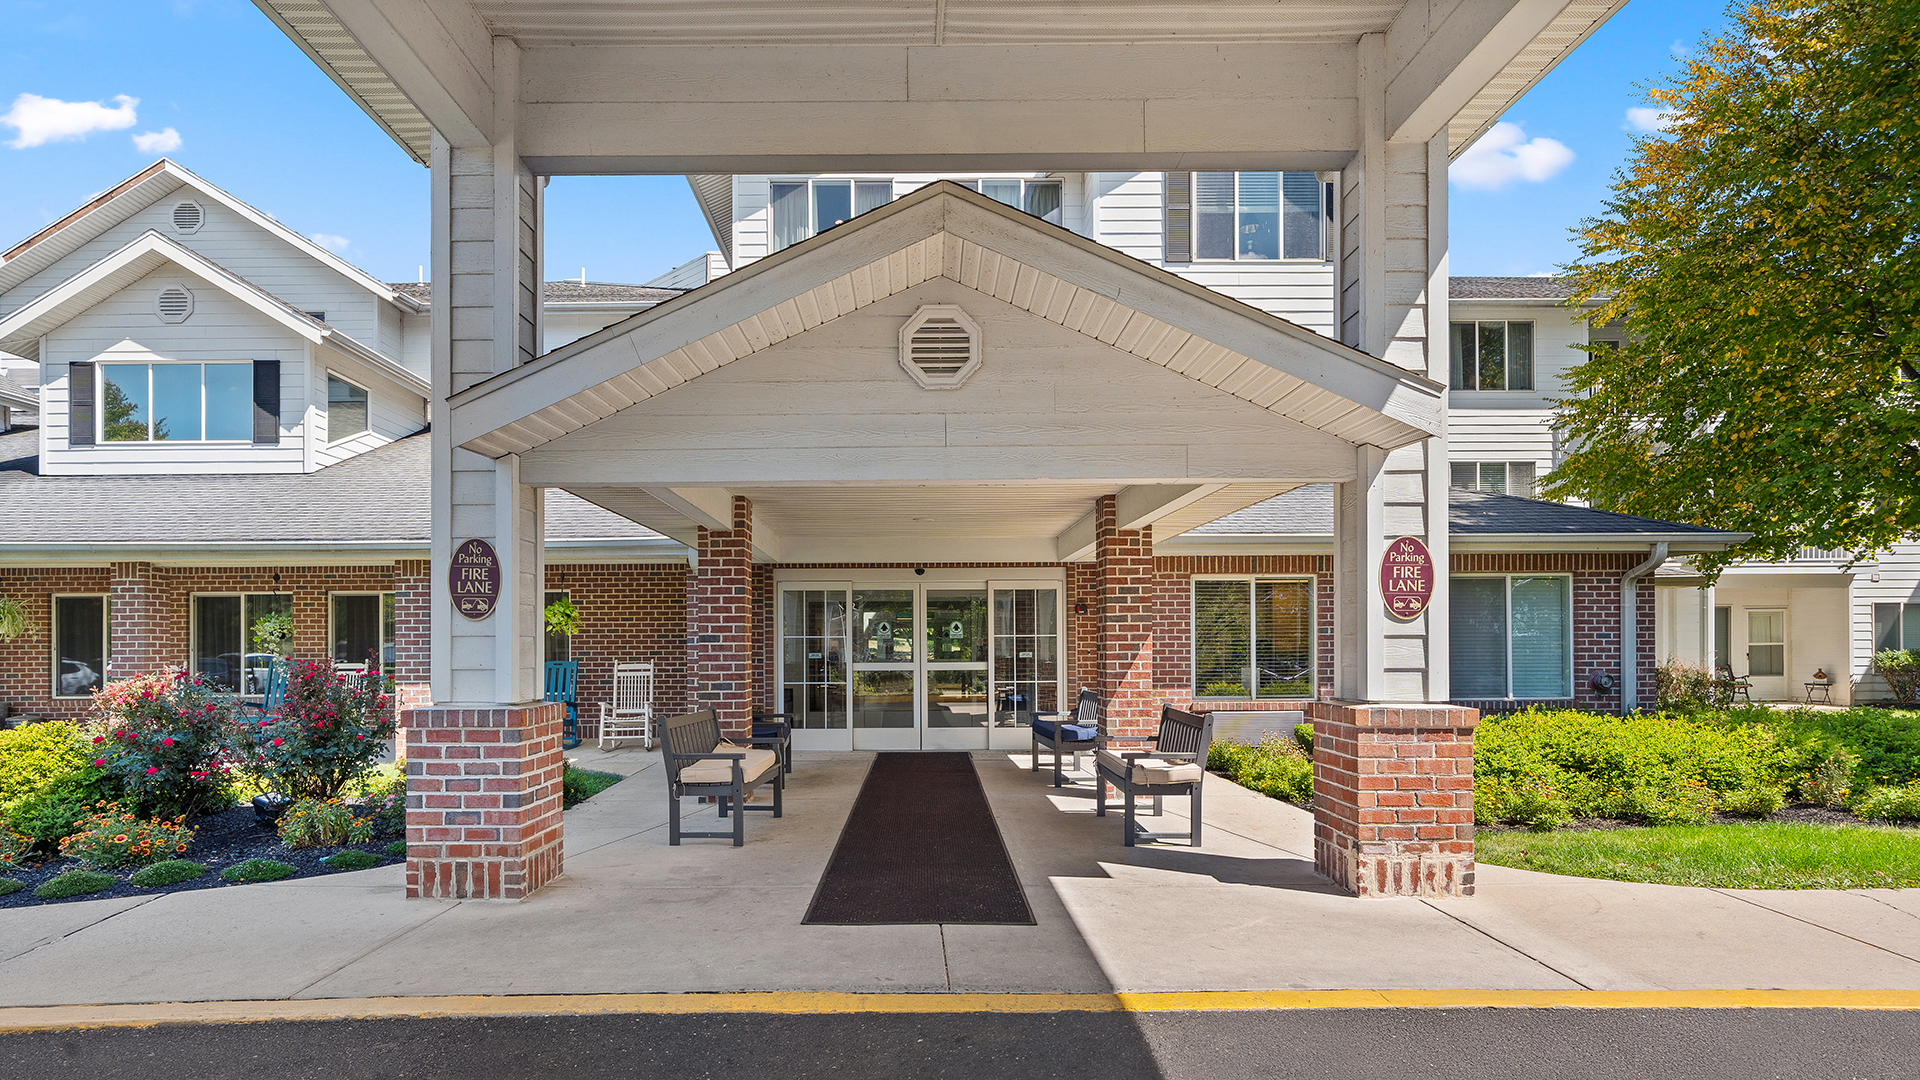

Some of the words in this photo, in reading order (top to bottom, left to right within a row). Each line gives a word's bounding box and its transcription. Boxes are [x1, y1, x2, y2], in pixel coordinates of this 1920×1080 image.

[468, 544, 482, 554] No
[1400, 542, 1414, 552] No
[458, 554, 492, 566] Parking
[1390, 552, 1424, 564] Parking
[462, 568, 488, 580] FIRE
[1393, 566, 1421, 578] FIRE
[457, 581, 492, 593] LANE
[1389, 579, 1425, 592] LANE
